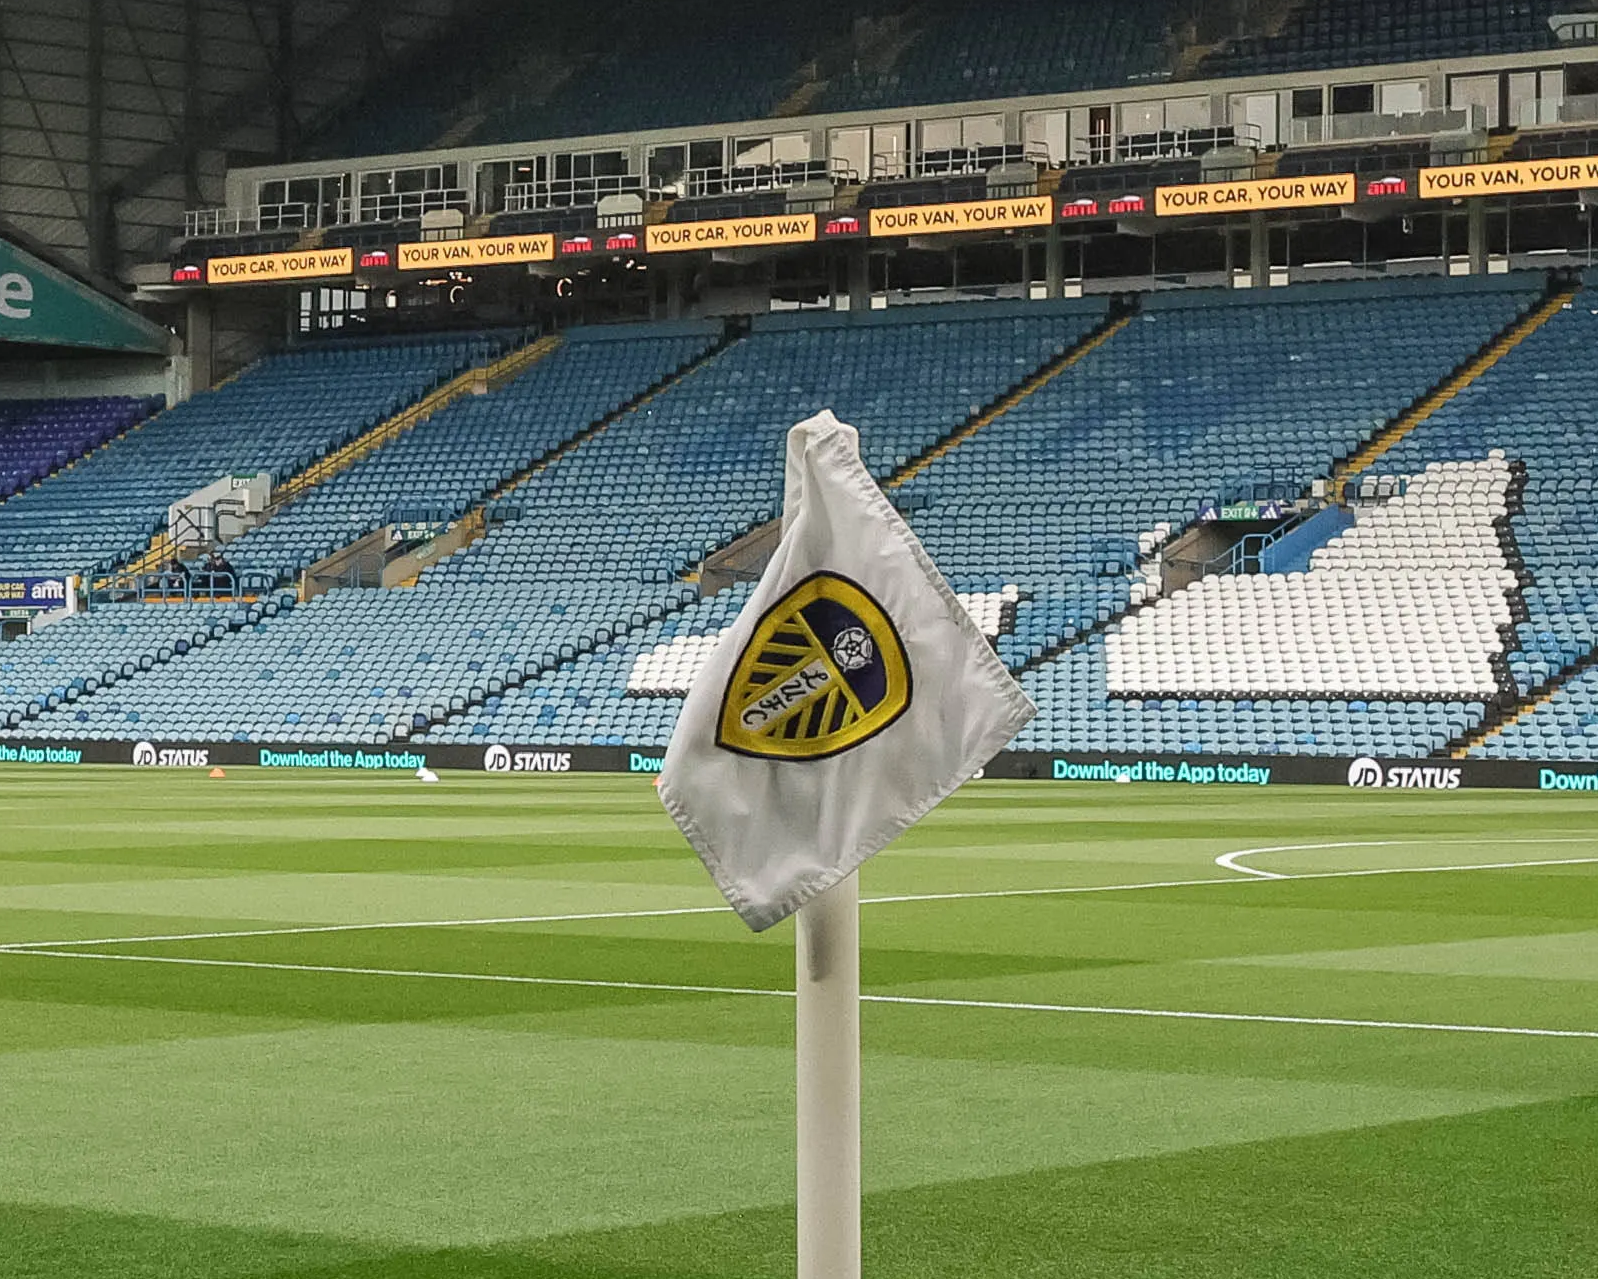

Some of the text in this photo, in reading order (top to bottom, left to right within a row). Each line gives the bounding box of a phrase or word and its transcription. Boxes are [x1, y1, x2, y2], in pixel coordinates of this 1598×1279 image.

[1425, 172, 1476, 190] YOUR
[1480, 168, 1524, 186] VAN,
[1528, 164, 1581, 183] YOUR
[1161, 180, 1348, 208] YOUR CAR, YOUR WAY
[875, 202, 1046, 229] YOUR VAN, YOUR WAY
[1221, 506, 1243, 519] EXIT
[31, 583, 65, 599] amt
[19, 747, 43, 763] App
[45, 748, 82, 764] today
[159, 749, 209, 765] STATUS
[260, 749, 426, 769] Download the App today
[513, 753, 571, 771] STATUS
[1054, 760, 1270, 784] Download the App today
[1386, 767, 1462, 788] STATUS
